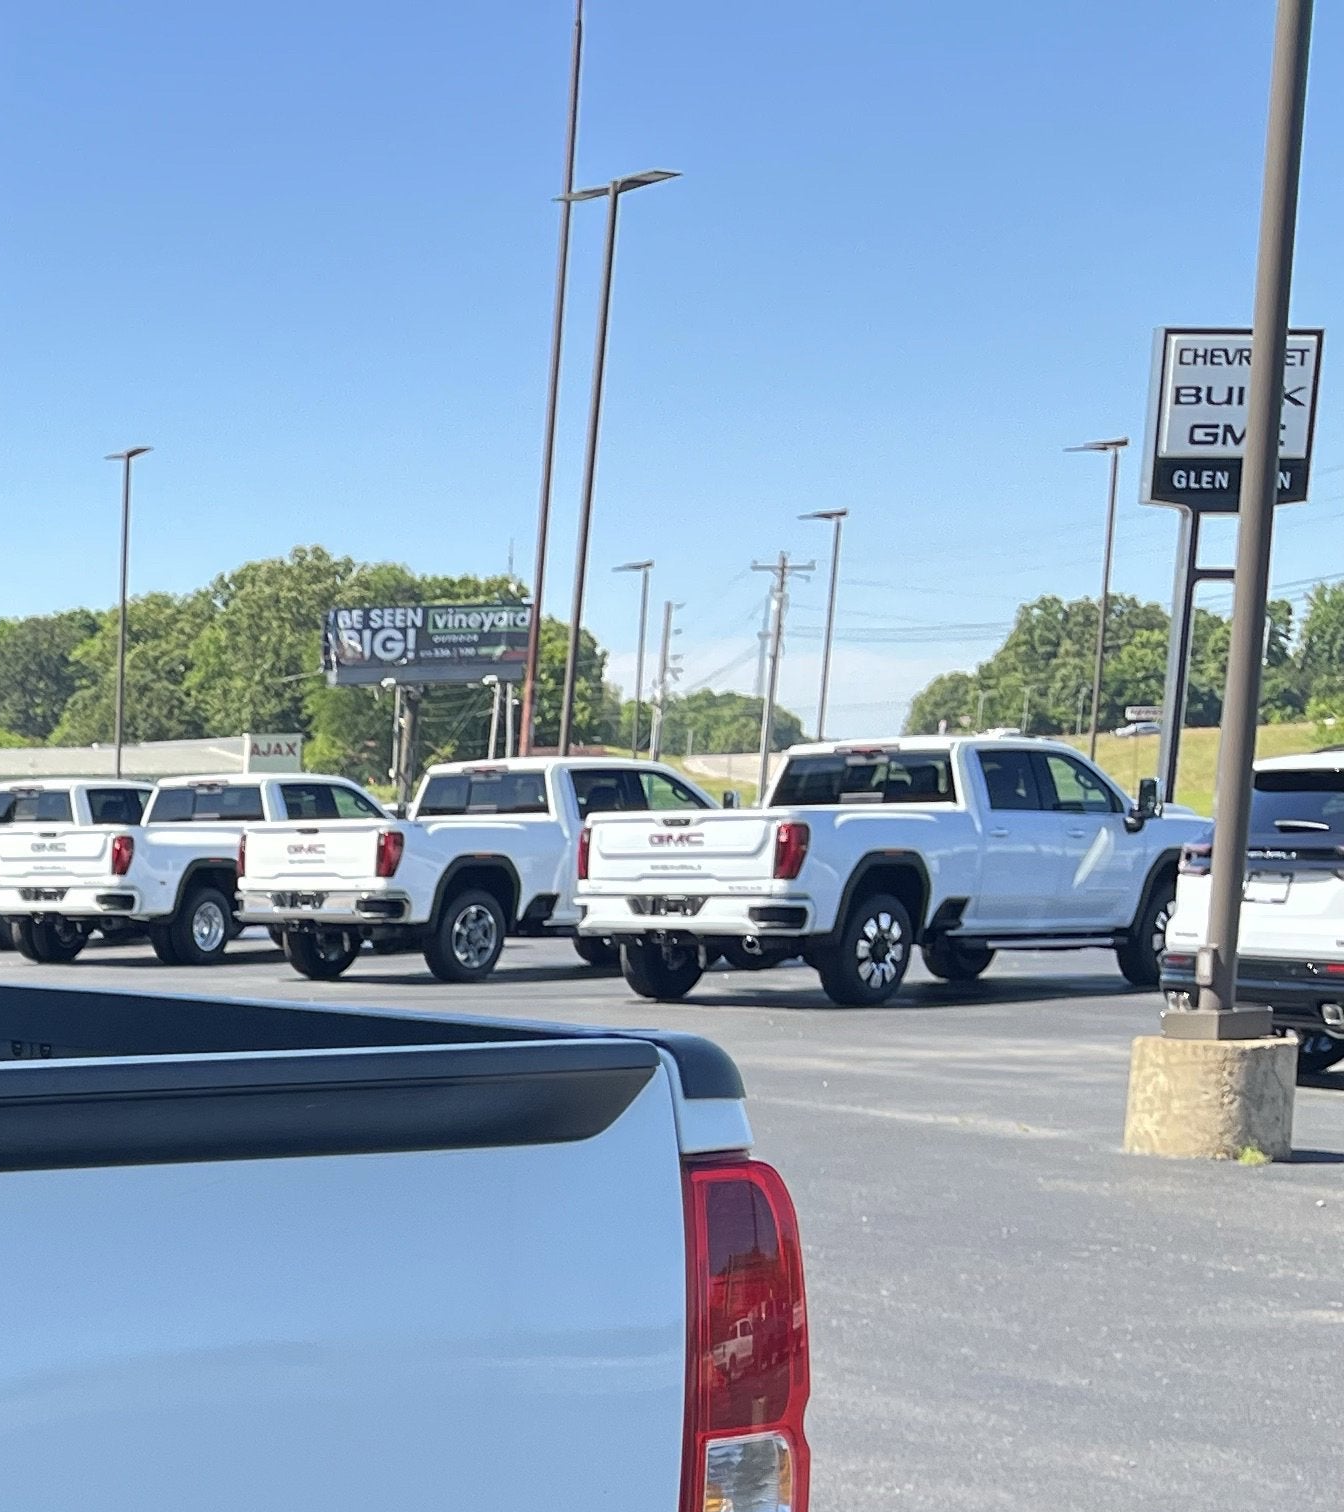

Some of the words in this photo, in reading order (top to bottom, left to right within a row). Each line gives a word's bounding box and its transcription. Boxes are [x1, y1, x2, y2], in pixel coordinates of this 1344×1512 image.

[1178, 347, 1310, 367] CHEVRET
[1174, 385, 1307, 407] BUIK
[1188, 423, 1286, 447] GM
[1172, 469, 1229, 490] GLEN
[337, 609, 363, 629] BE
[369, 607, 423, 629] SEEN
[434, 607, 531, 632] vineyard
[251, 742, 297, 757] AJAX
[648, 832, 705, 847] GMC
